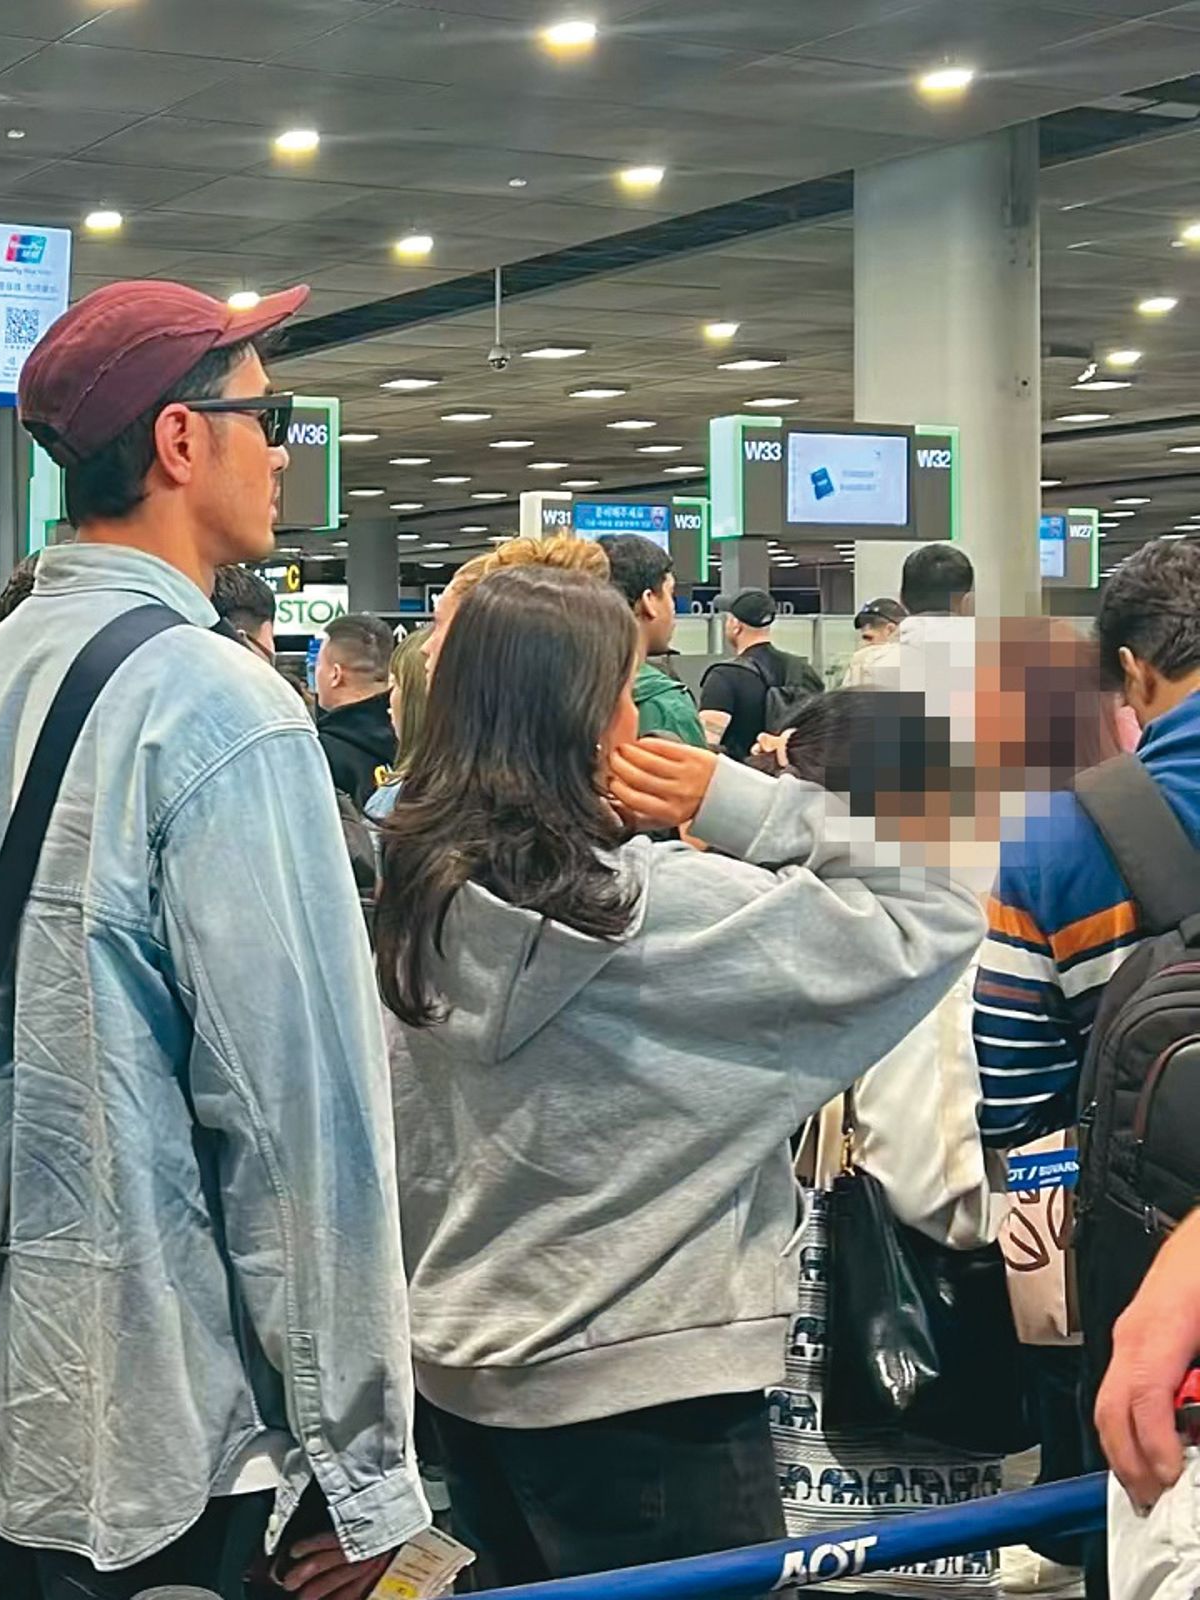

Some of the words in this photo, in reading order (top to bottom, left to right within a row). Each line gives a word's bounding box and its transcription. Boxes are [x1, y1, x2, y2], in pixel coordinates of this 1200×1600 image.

[287, 423, 328, 445] W36
[745, 441, 782, 461] W33
[917, 449, 951, 468] W32
[543, 509, 572, 525] W31
[674, 514, 701, 529] W30
[287, 564, 300, 590] C
[770, 1535, 878, 1591] AOT
